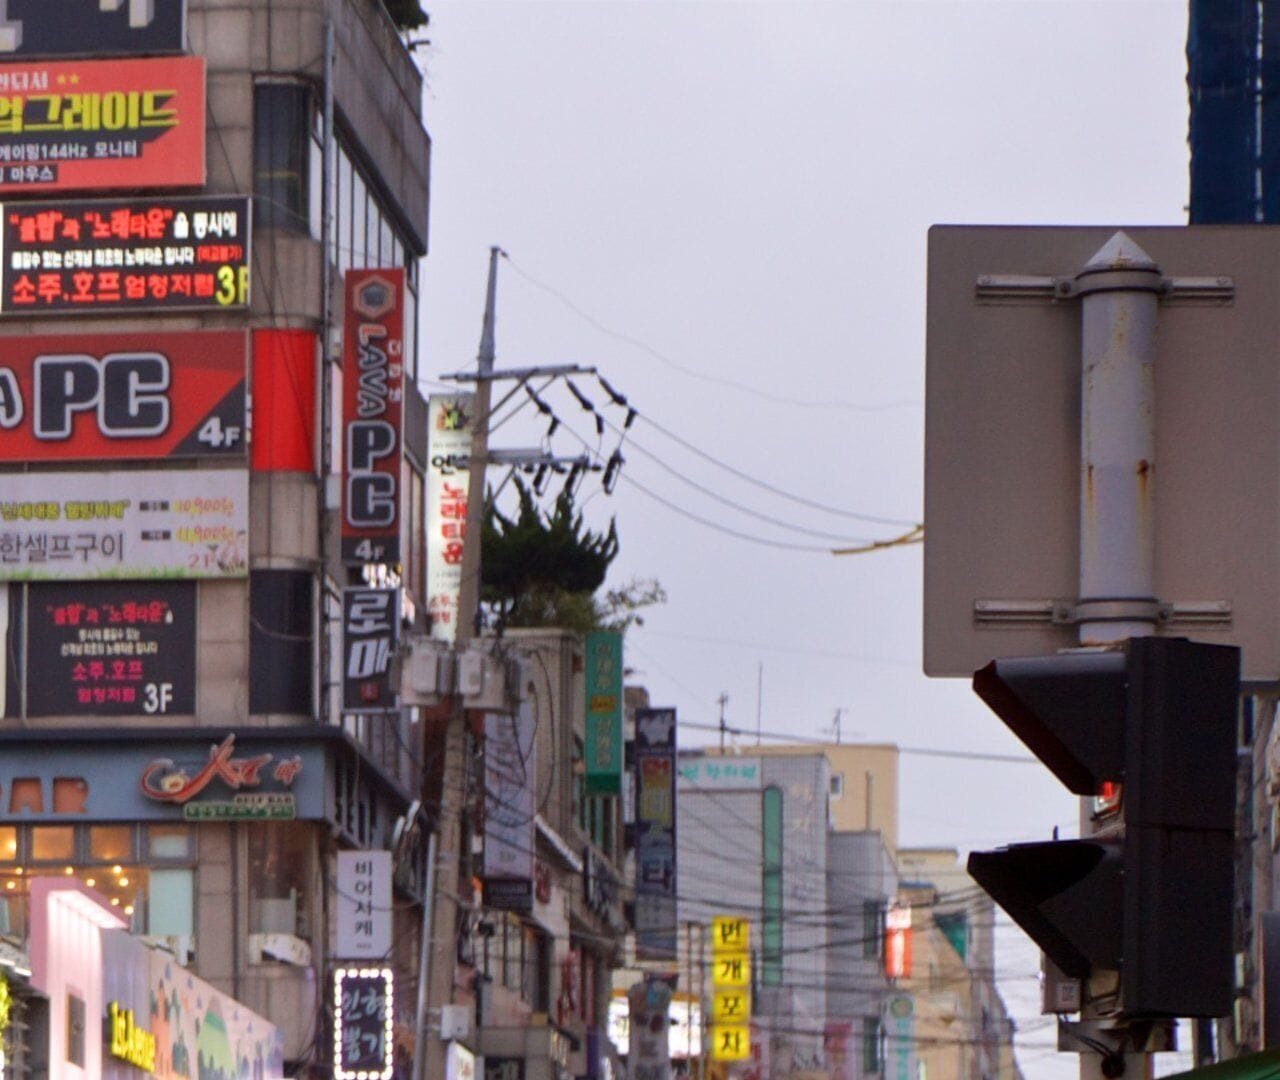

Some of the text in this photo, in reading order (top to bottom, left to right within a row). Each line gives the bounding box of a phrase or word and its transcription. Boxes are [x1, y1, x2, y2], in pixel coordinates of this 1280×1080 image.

[33, 353, 170, 441] PC
[197, 417, 240, 446] 4F
[347, 420, 395, 528] PC
[143, 683, 174, 713] 3F
[720, 922, 742, 1054] 번개포차
